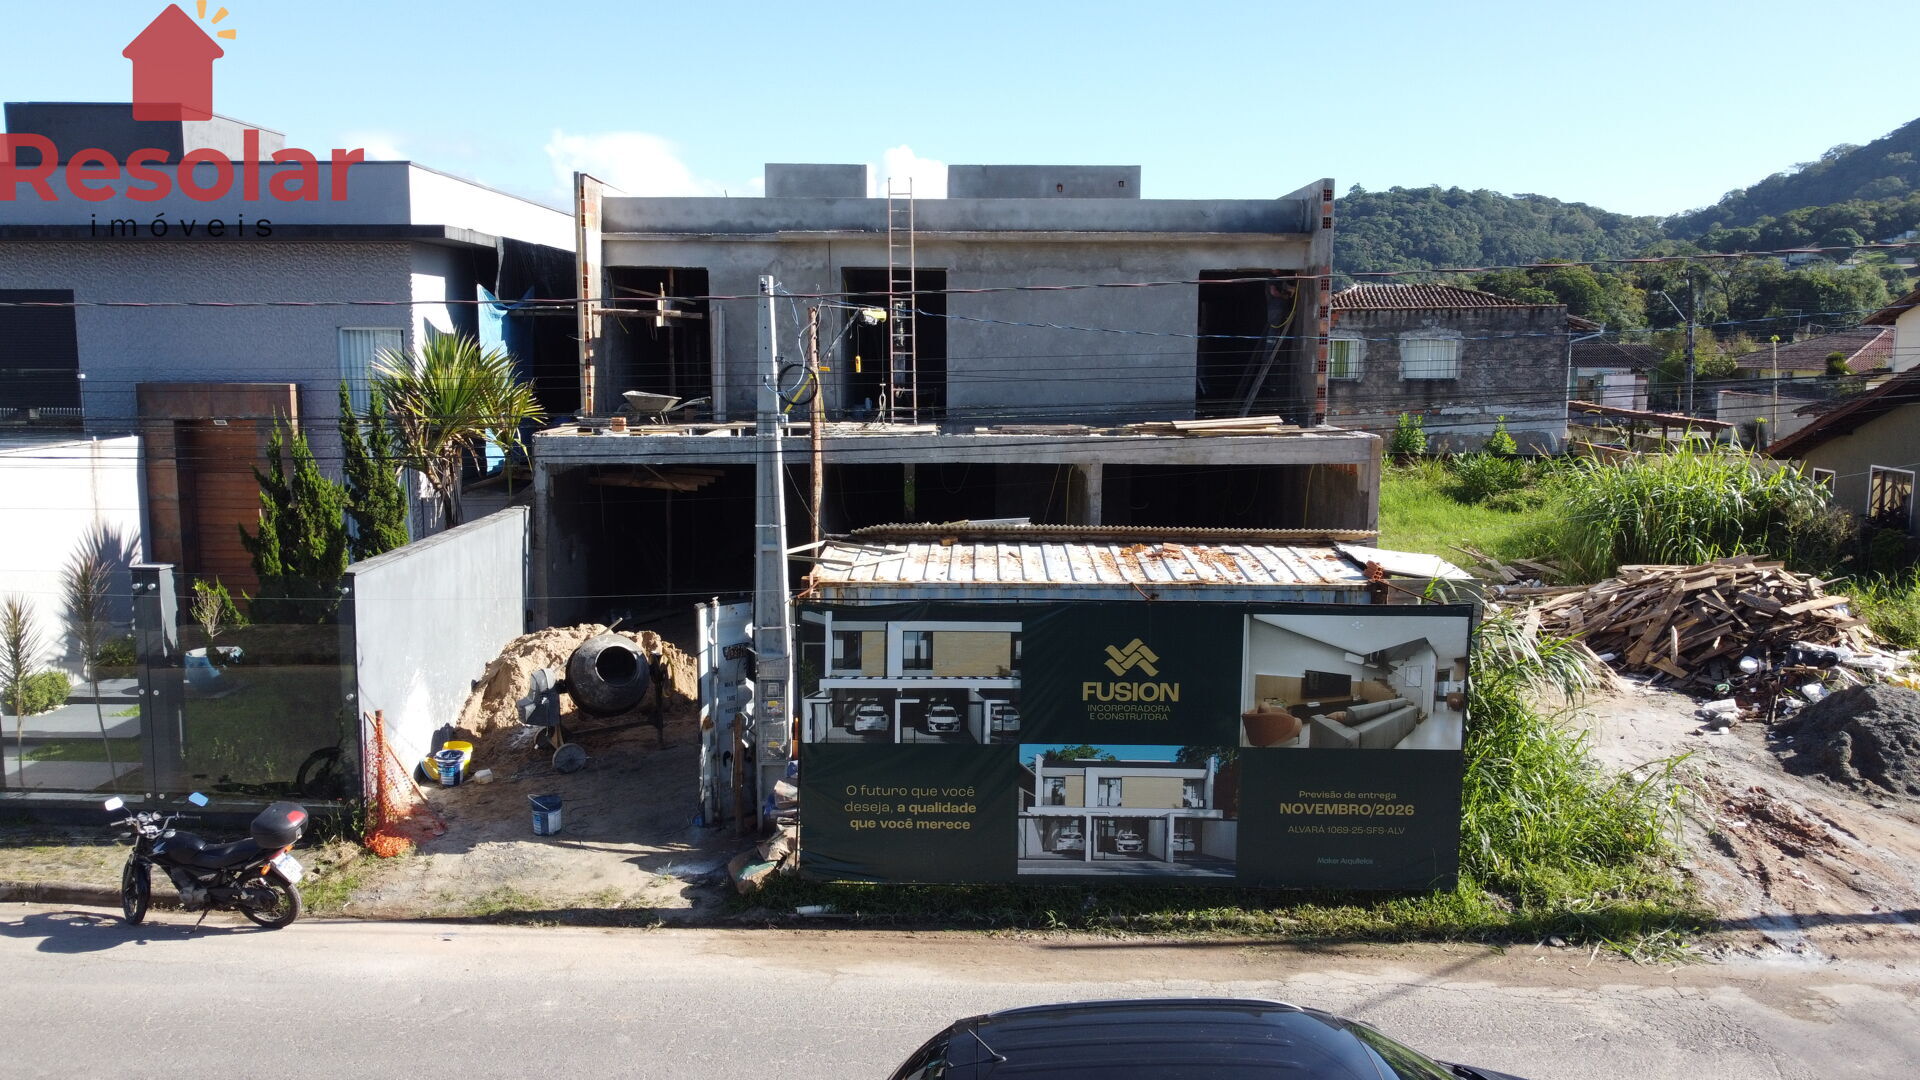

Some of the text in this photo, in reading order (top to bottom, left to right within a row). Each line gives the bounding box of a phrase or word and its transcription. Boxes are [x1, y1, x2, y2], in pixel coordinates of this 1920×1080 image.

[1082, 681, 1180, 702] FUSION
[1087, 704, 1171, 712] INCORPORADORA
[1089, 712, 1168, 721] E CONSTRUTORA
[846, 785, 975, 798] O futuro que você
[1298, 791, 1397, 801] Previsão de entrega
[844, 801, 977, 815] deseja, a qualidade
[1280, 803, 1415, 819] NOVEMBRO/2026
[850, 818, 971, 831] que você merece
[1288, 825, 1325, 834] ALVARÁ
